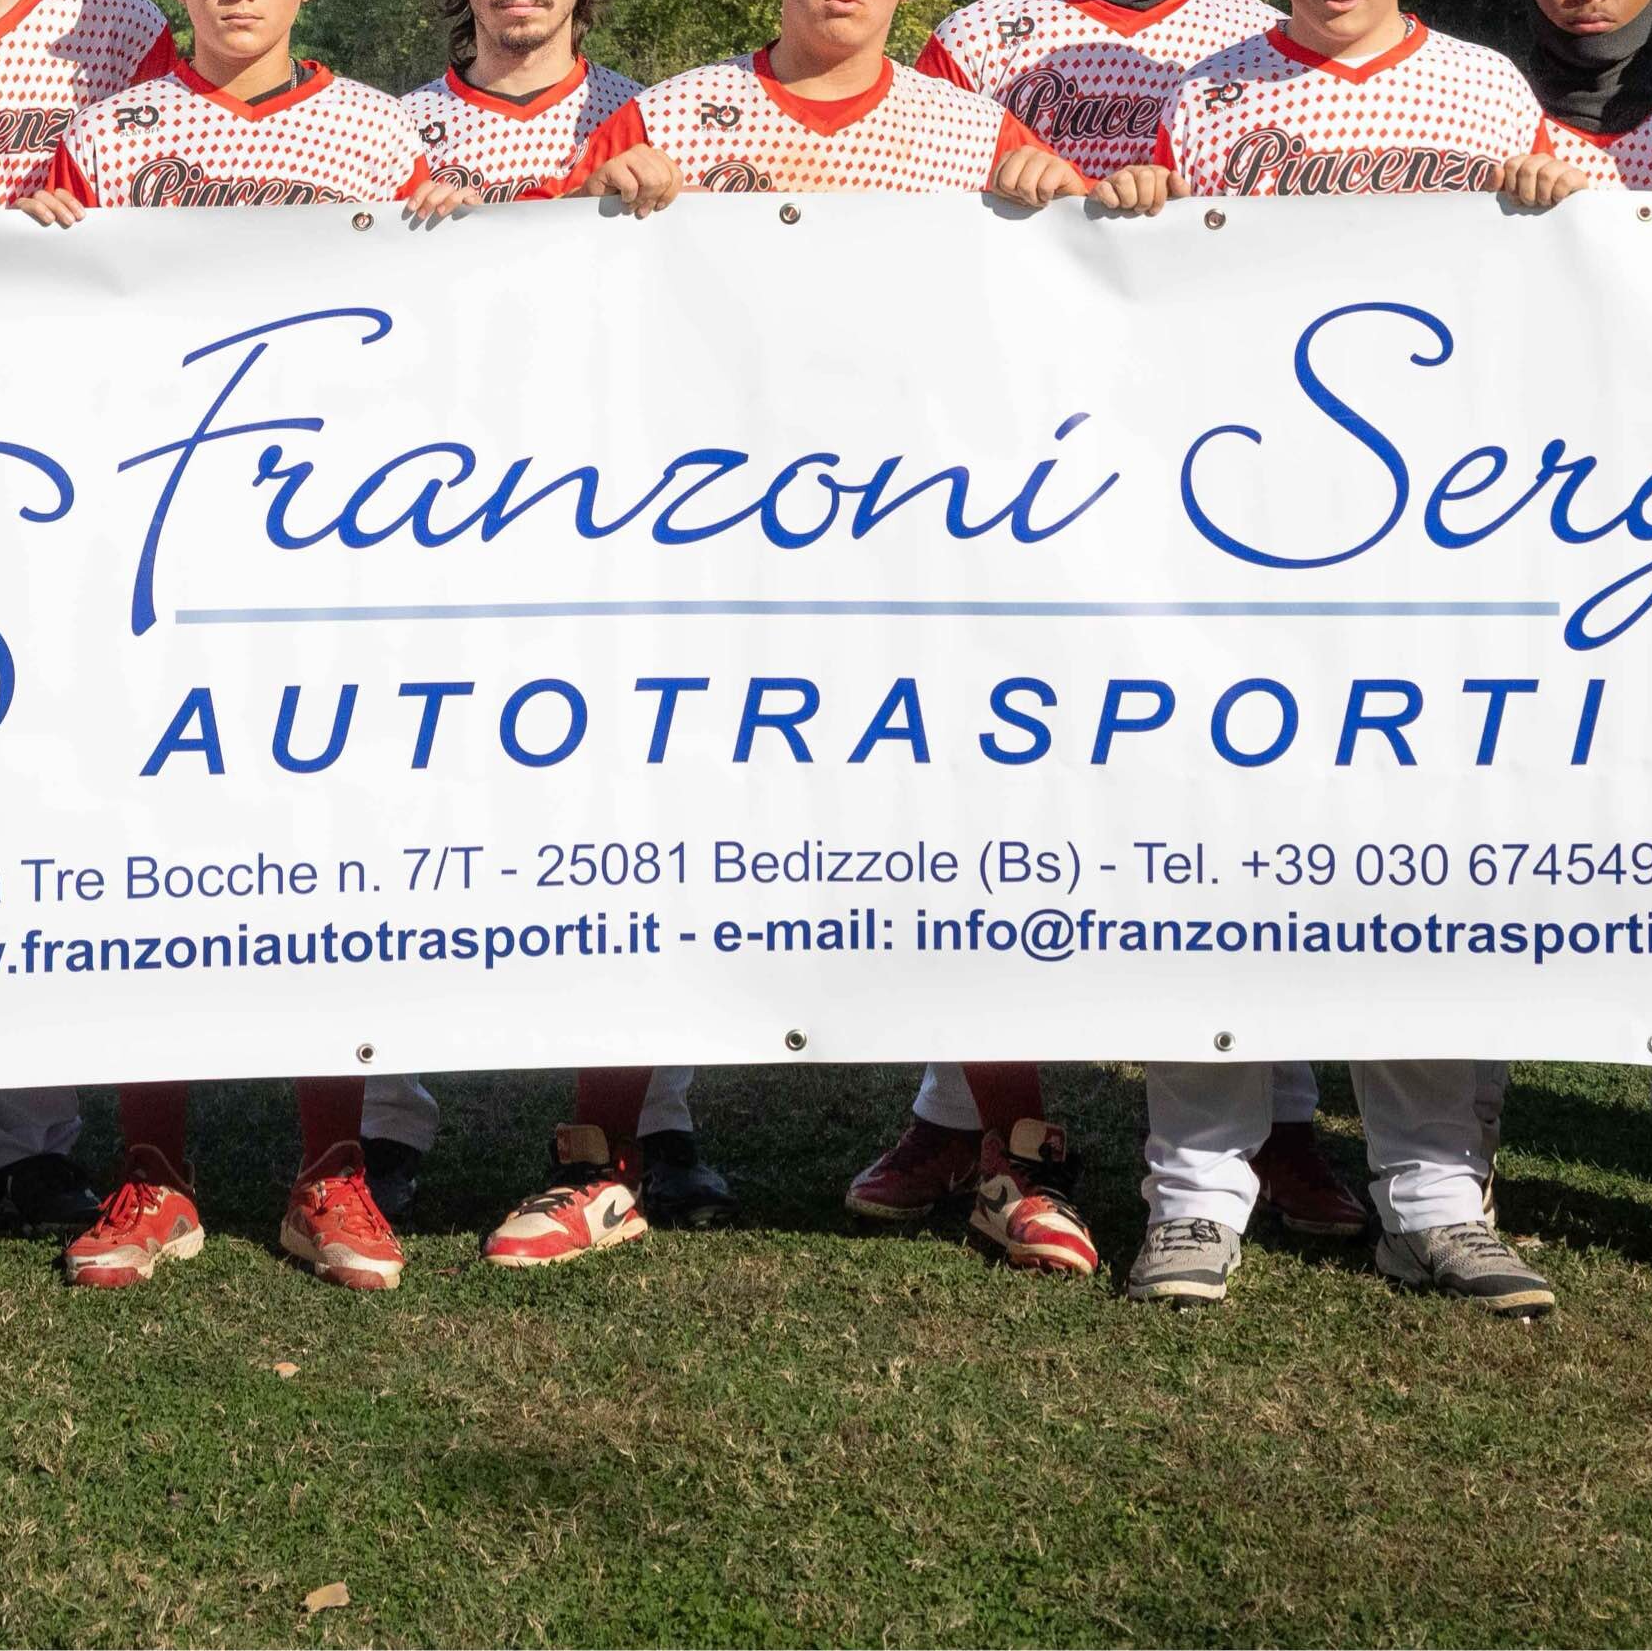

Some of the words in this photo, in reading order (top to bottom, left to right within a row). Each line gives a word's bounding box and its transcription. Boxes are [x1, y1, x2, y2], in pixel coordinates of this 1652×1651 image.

[117, 307, 1119, 637] Franzoni
[140, 676, 1606, 777] AUTOTRASPORTI
[21, 859, 105, 903] Tre
[125, 854, 318, 900] Bocche
[338, 862, 381, 893] n.
[402, 846, 483, 892] 7/T
[536, 841, 686, 887] 25081
[713, 841, 958, 884] Bedizzole
[979, 841, 1081, 893] (Bs)
[1133, 841, 1220, 884] Tel.
[1241, 844, 1336, 885] +39
[1356, 844, 1450, 886] 030
[713, 908, 893, 953] e-mail:
